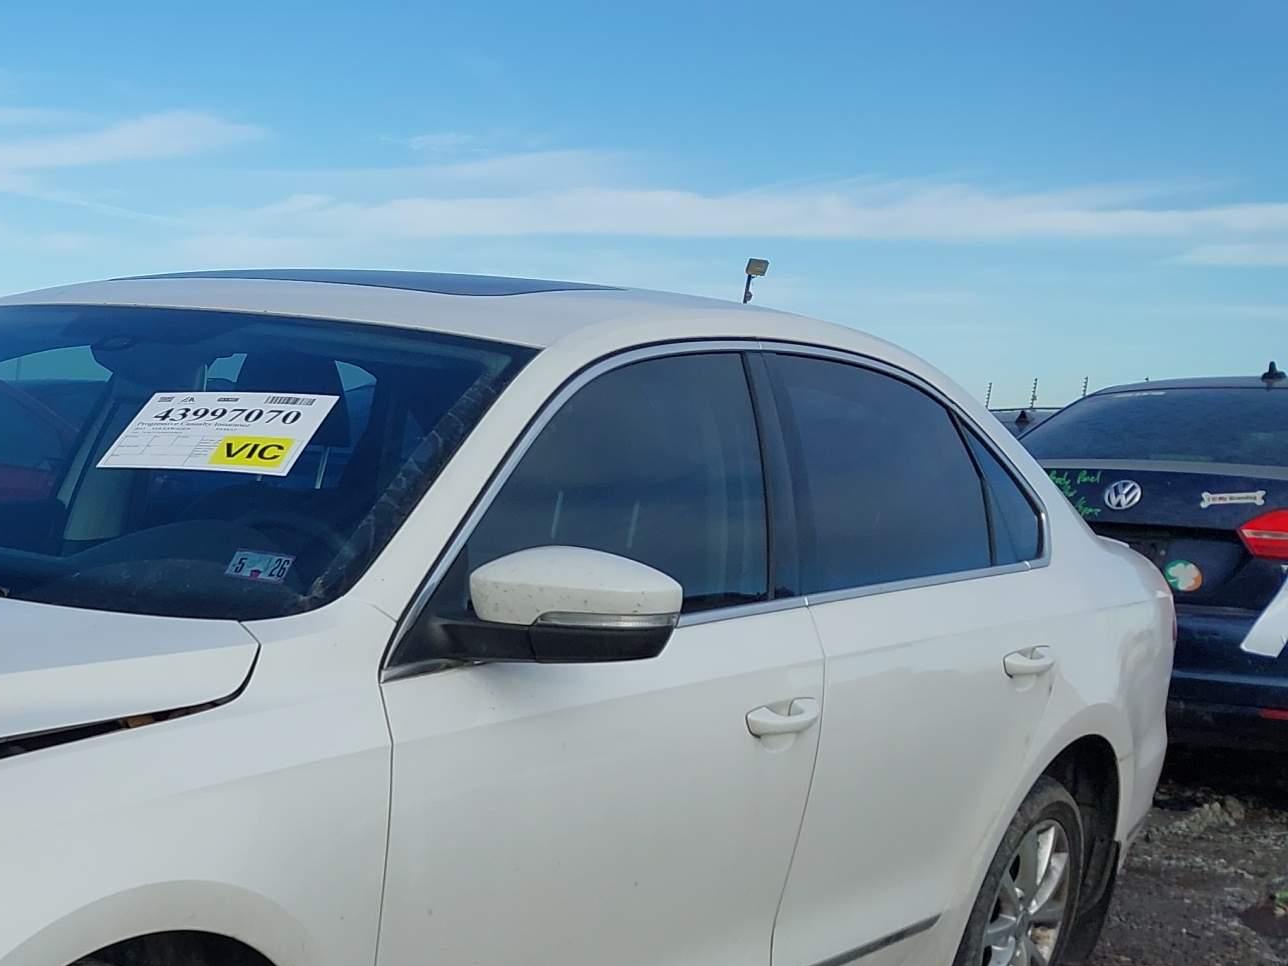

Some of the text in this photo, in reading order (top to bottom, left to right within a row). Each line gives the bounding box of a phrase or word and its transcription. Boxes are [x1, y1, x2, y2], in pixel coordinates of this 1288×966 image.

[153, 407, 302, 425] 43997070
[224, 441, 285, 461] VIC
[233, 557, 290, 578] 5 26
